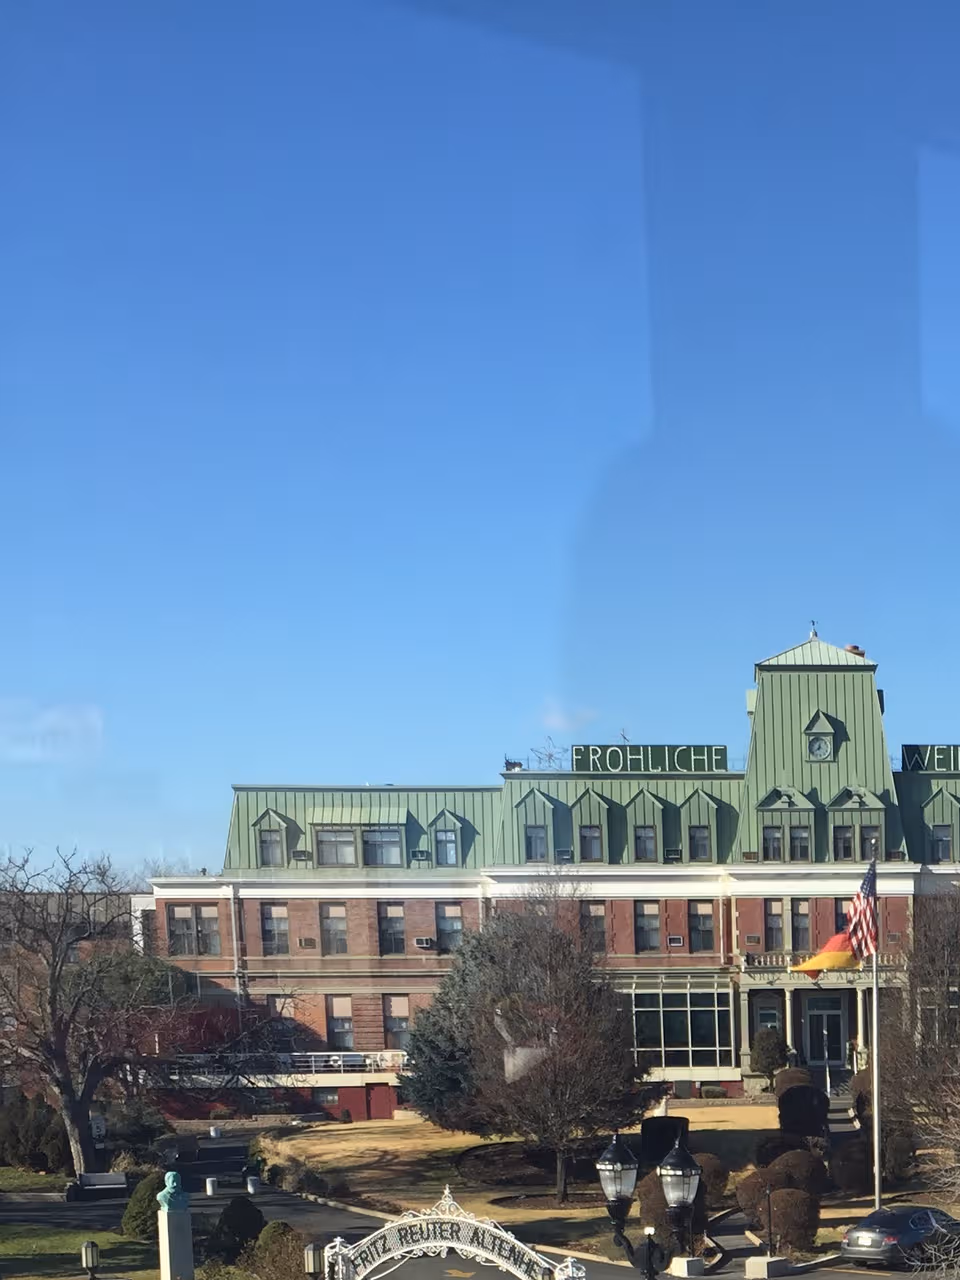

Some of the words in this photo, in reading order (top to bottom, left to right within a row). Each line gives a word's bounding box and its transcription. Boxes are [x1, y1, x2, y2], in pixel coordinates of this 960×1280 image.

[572, 746, 726, 772] FROHLICHE
[351, 1235, 387, 1276] FRITZ
[397, 1221, 460, 1247] REUTER
